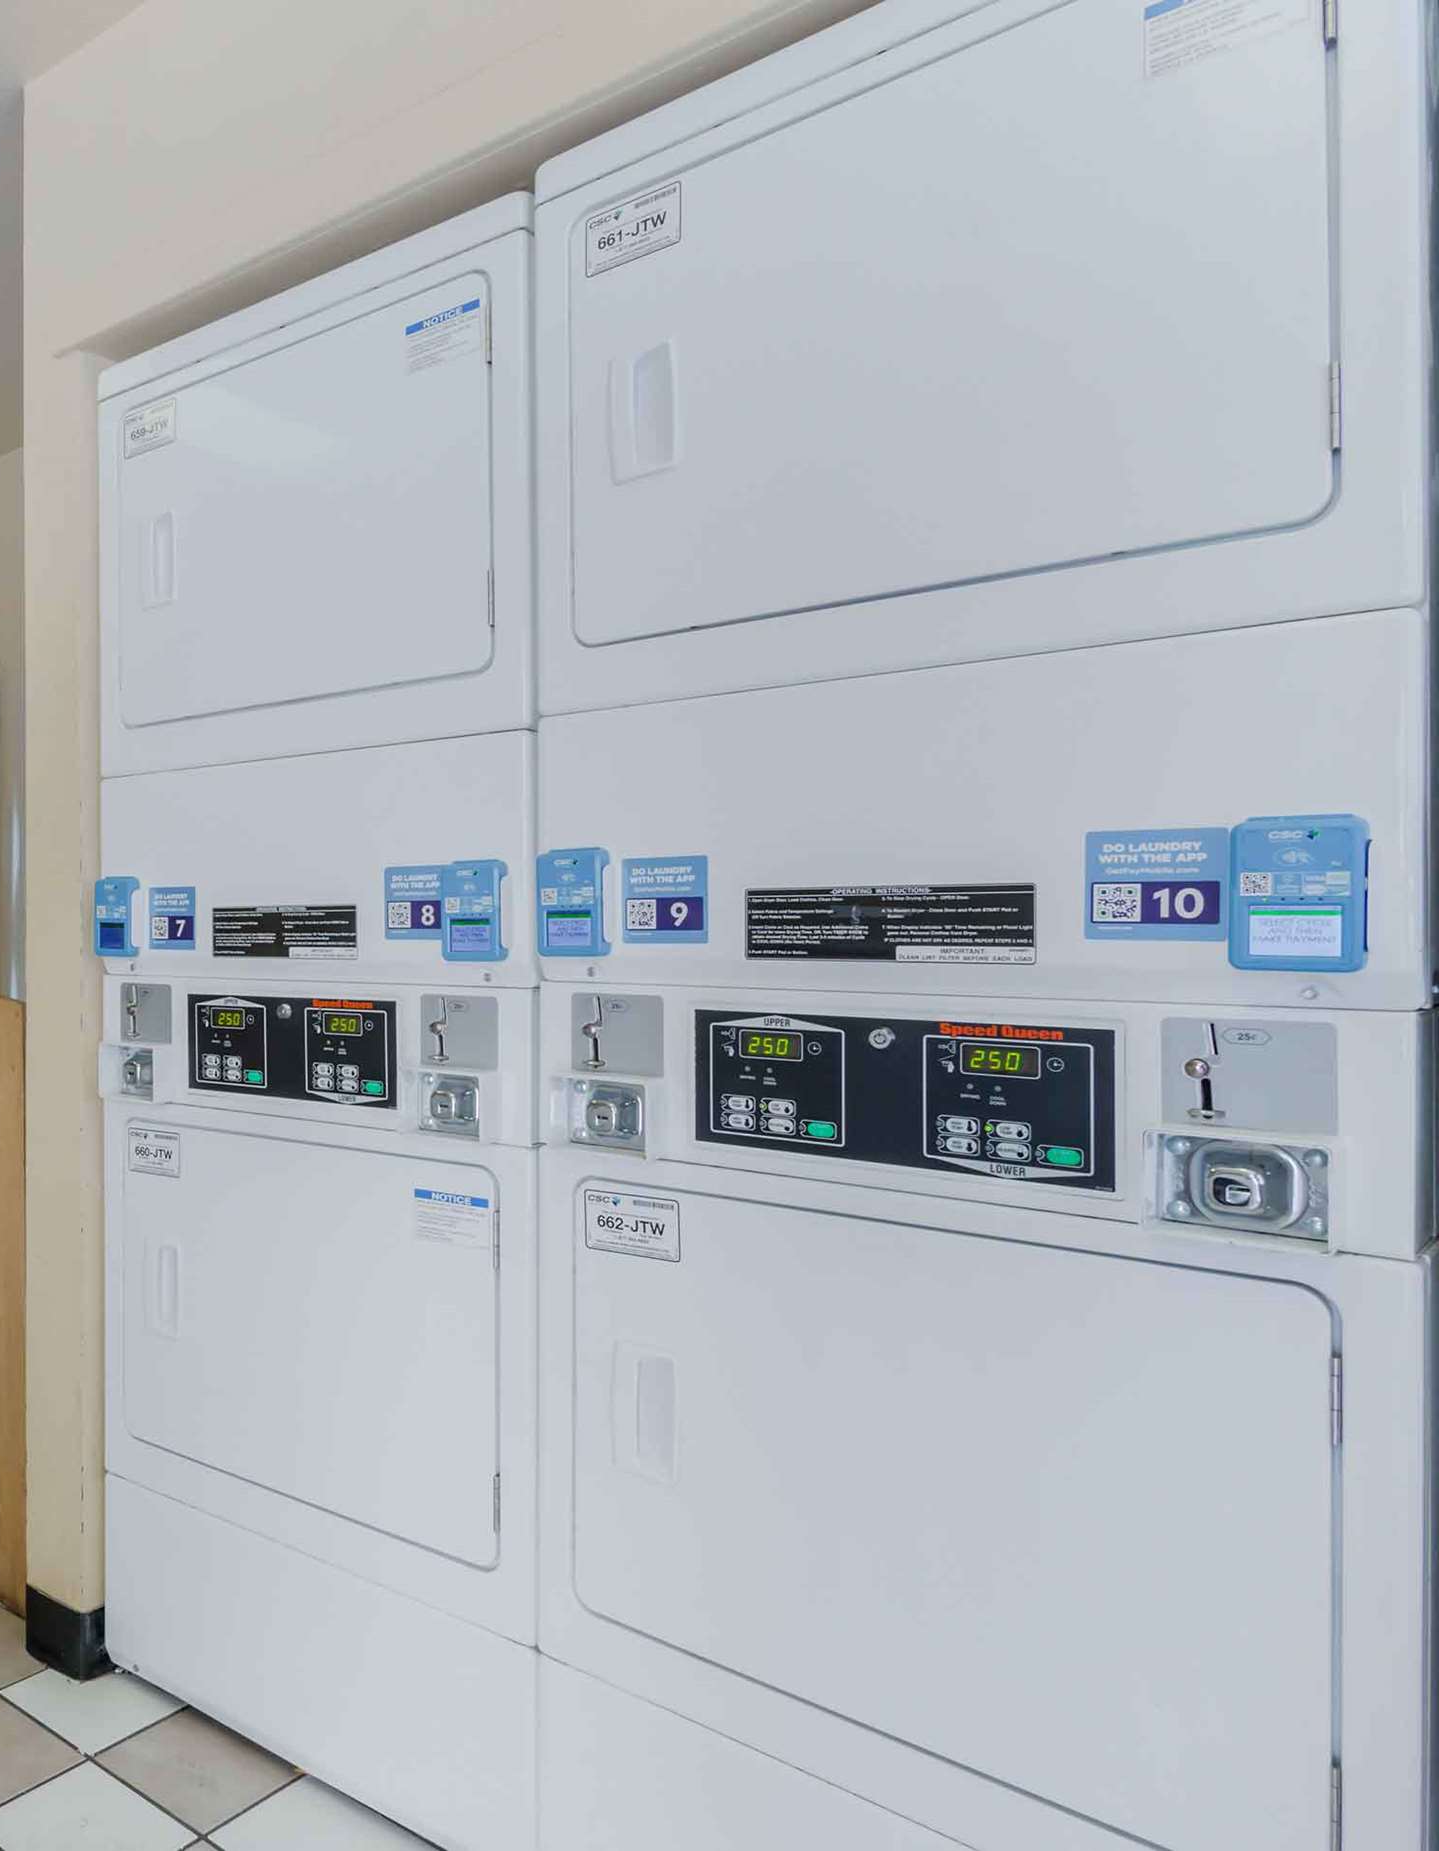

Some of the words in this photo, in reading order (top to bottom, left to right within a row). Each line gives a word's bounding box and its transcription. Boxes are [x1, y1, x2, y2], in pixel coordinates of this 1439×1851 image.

[598, 210, 667, 250] 661-JTW
[423, 306, 464, 328] NOTICE
[1103, 843, 1125, 853] DO
[1128, 841, 1202, 852] LAUNDRY
[1098, 854, 1138, 864] WITH
[1141, 853, 1172, 863] THE
[1175, 853, 1208, 862] APP
[1152, 887, 1205, 919] 10
[421, 904, 435, 926] 8
[670, 902, 689, 927] 9
[175, 919, 186, 937] 7
[218, 1012, 240, 1025] 250
[330, 1018, 356, 1032] 250
[763, 1018, 791, 1027] UPPER
[939, 1022, 997, 1037] Speed
[1002, 1025, 1064, 1040] Queen
[748, 1037, 789, 1055] 250
[970, 1050, 1021, 1071] 250
[135, 1145, 173, 1159] 660-JTW
[989, 1163, 1027, 1176] LOWER
[431, 1191, 472, 1205] NOTICE
[597, 1214, 665, 1236] 662-JTW
